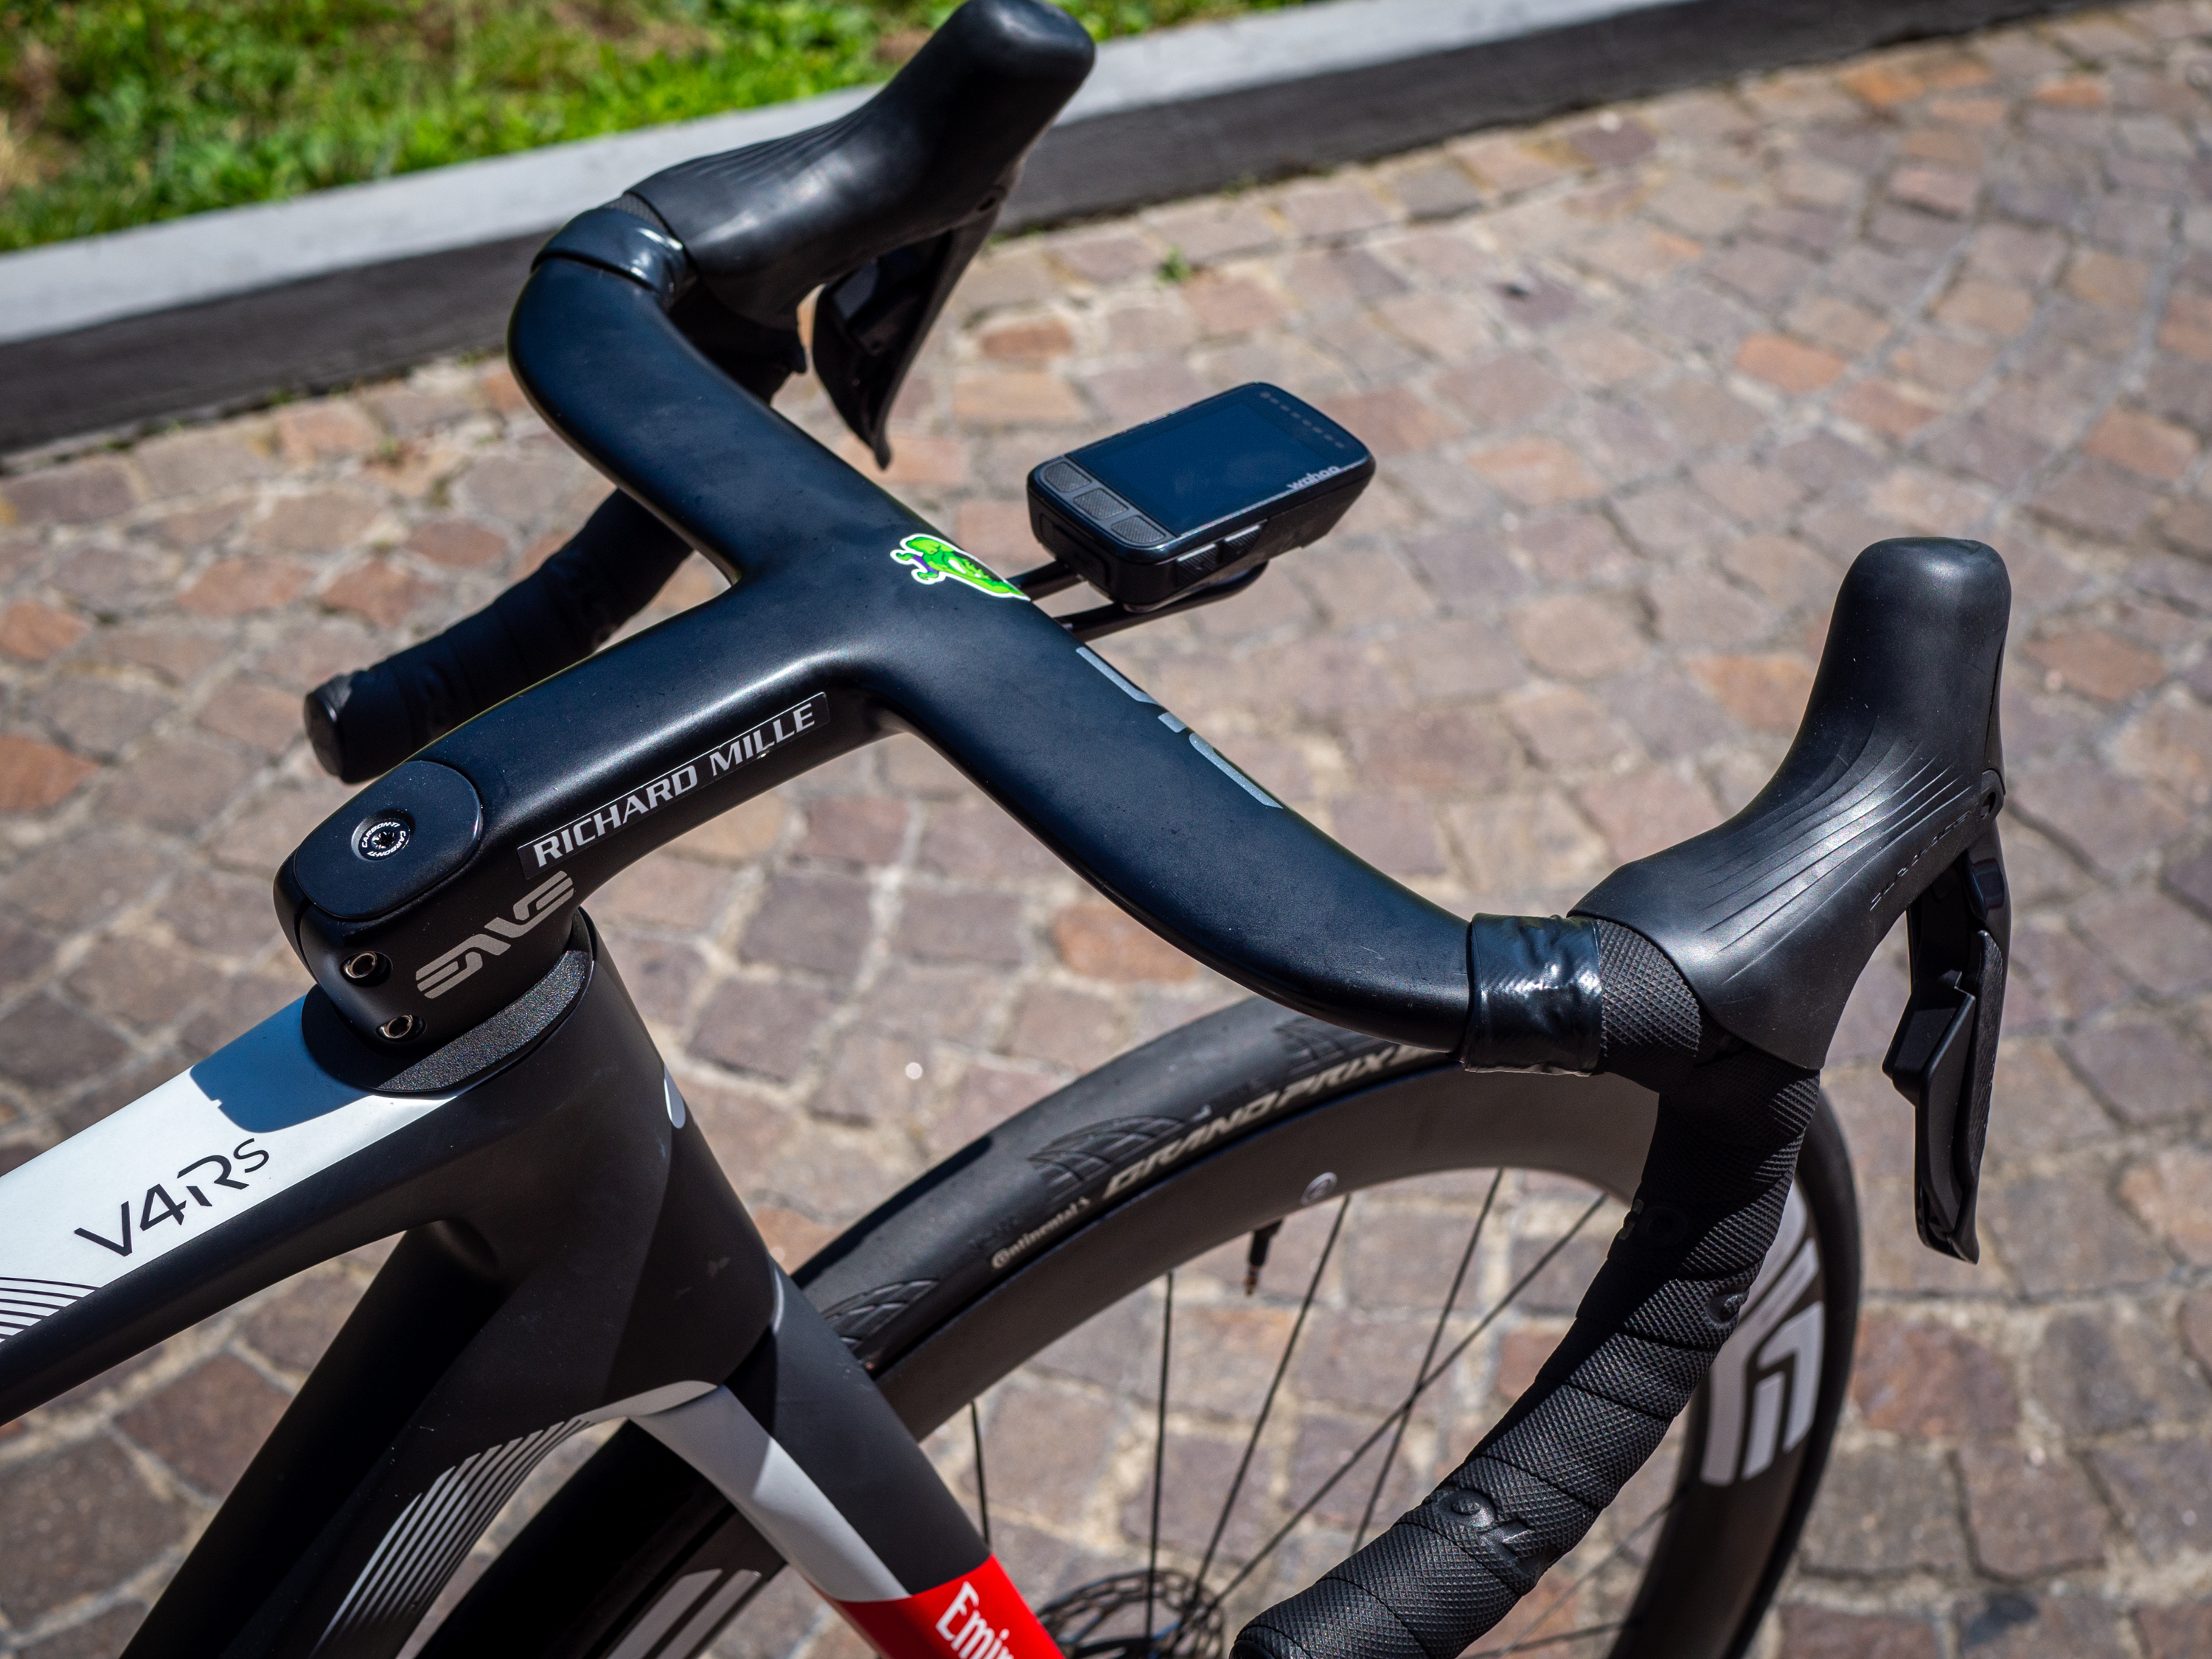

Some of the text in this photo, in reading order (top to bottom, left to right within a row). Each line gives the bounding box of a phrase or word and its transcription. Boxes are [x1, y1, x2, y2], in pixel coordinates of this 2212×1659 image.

[1286, 466, 1340, 490] wahoo
[532, 703, 816, 869] RICHARD MILLE
[415, 870, 574, 999] ENVE
[992, 1203, 1079, 1269] Continental
